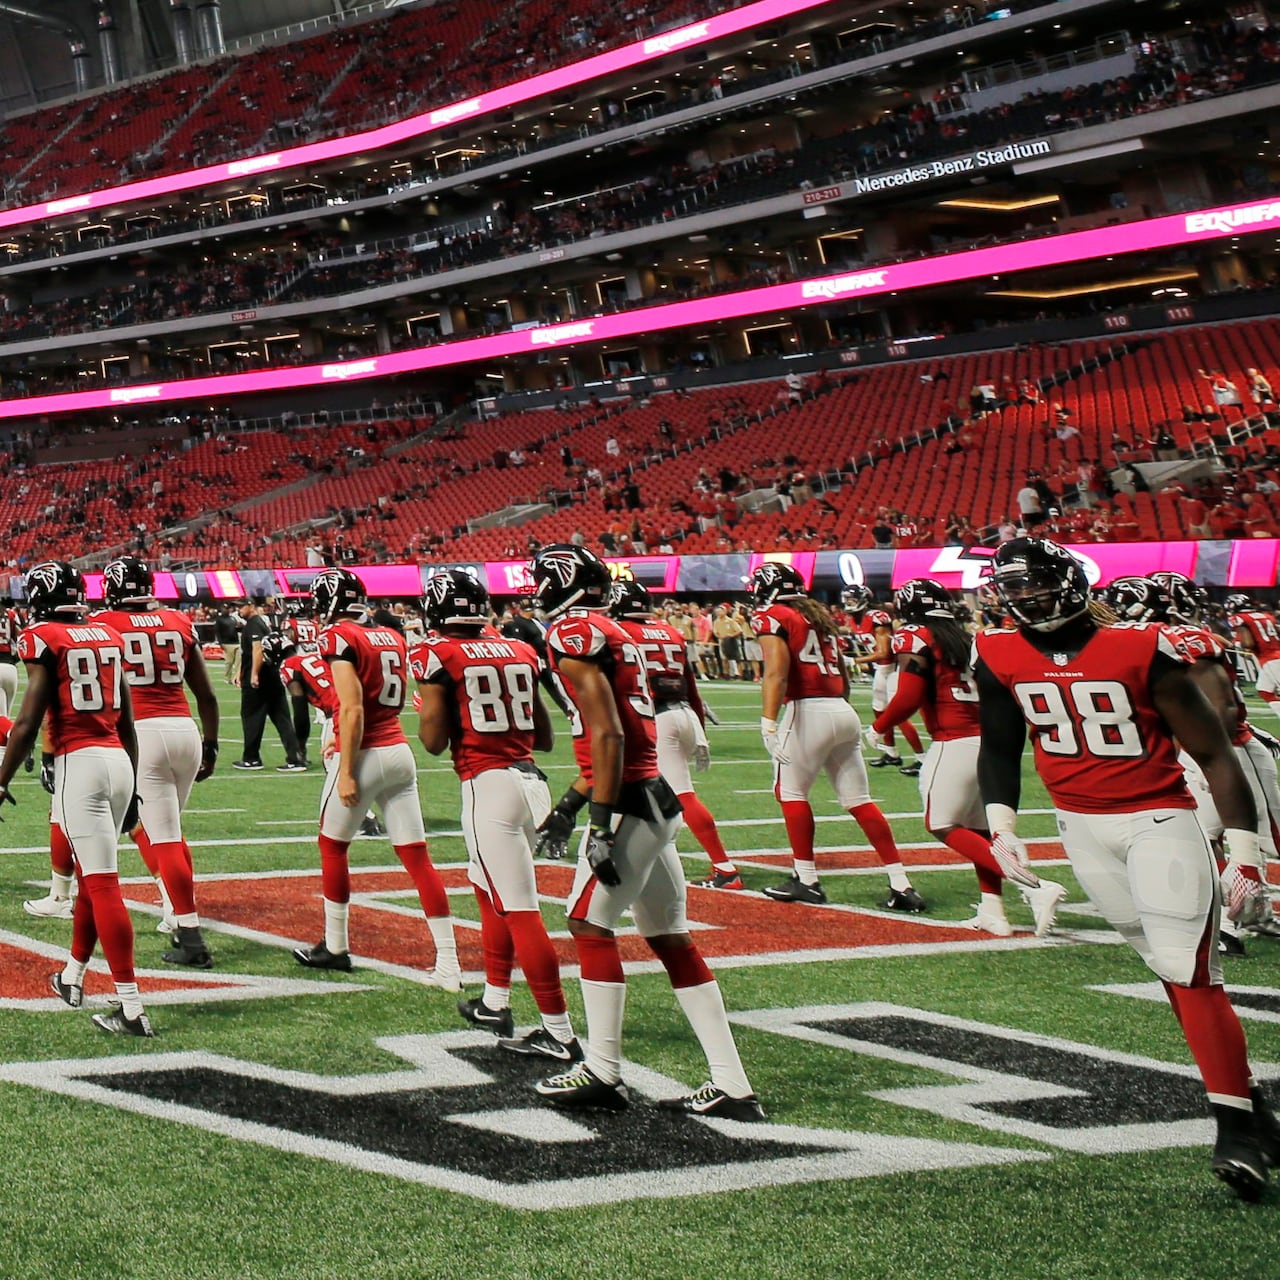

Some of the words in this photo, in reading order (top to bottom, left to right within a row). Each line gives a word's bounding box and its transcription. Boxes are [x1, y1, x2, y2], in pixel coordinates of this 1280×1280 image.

[644, 22, 710, 55] EQUIFAX
[855, 156, 974, 194] Mercedes-Benz
[976, 140, 1051, 167] Stadium
[804, 187, 840, 204] 210-211
[1185, 201, 1280, 233] EQUIFA
[802, 270, 888, 298] EQUIFAX
[1105, 315, 1127, 328] 110
[1167, 306, 1190, 319] 111
[531, 321, 595, 344] EQUIFAX
[889, 344, 906, 356] 110
[839, 553, 864, 585] 0
[185, 573, 198, 597] 0
[129, 615, 163, 627] ODOM
[1255, 620, 1280, 643] 14
[66, 628, 111, 643] BURTON
[298, 627, 316, 641] 97
[365, 631, 398, 646] MEYER
[642, 628, 671, 640] JONES
[124, 631, 185, 686] 93
[461, 643, 517, 658] CHERRY
[646, 644, 684, 674] 55
[799, 629, 841, 675] 43
[66, 647, 121, 711] 87
[379, 651, 401, 706] 6
[464, 665, 534, 732] 88
[1014, 681, 1143, 756] 98
